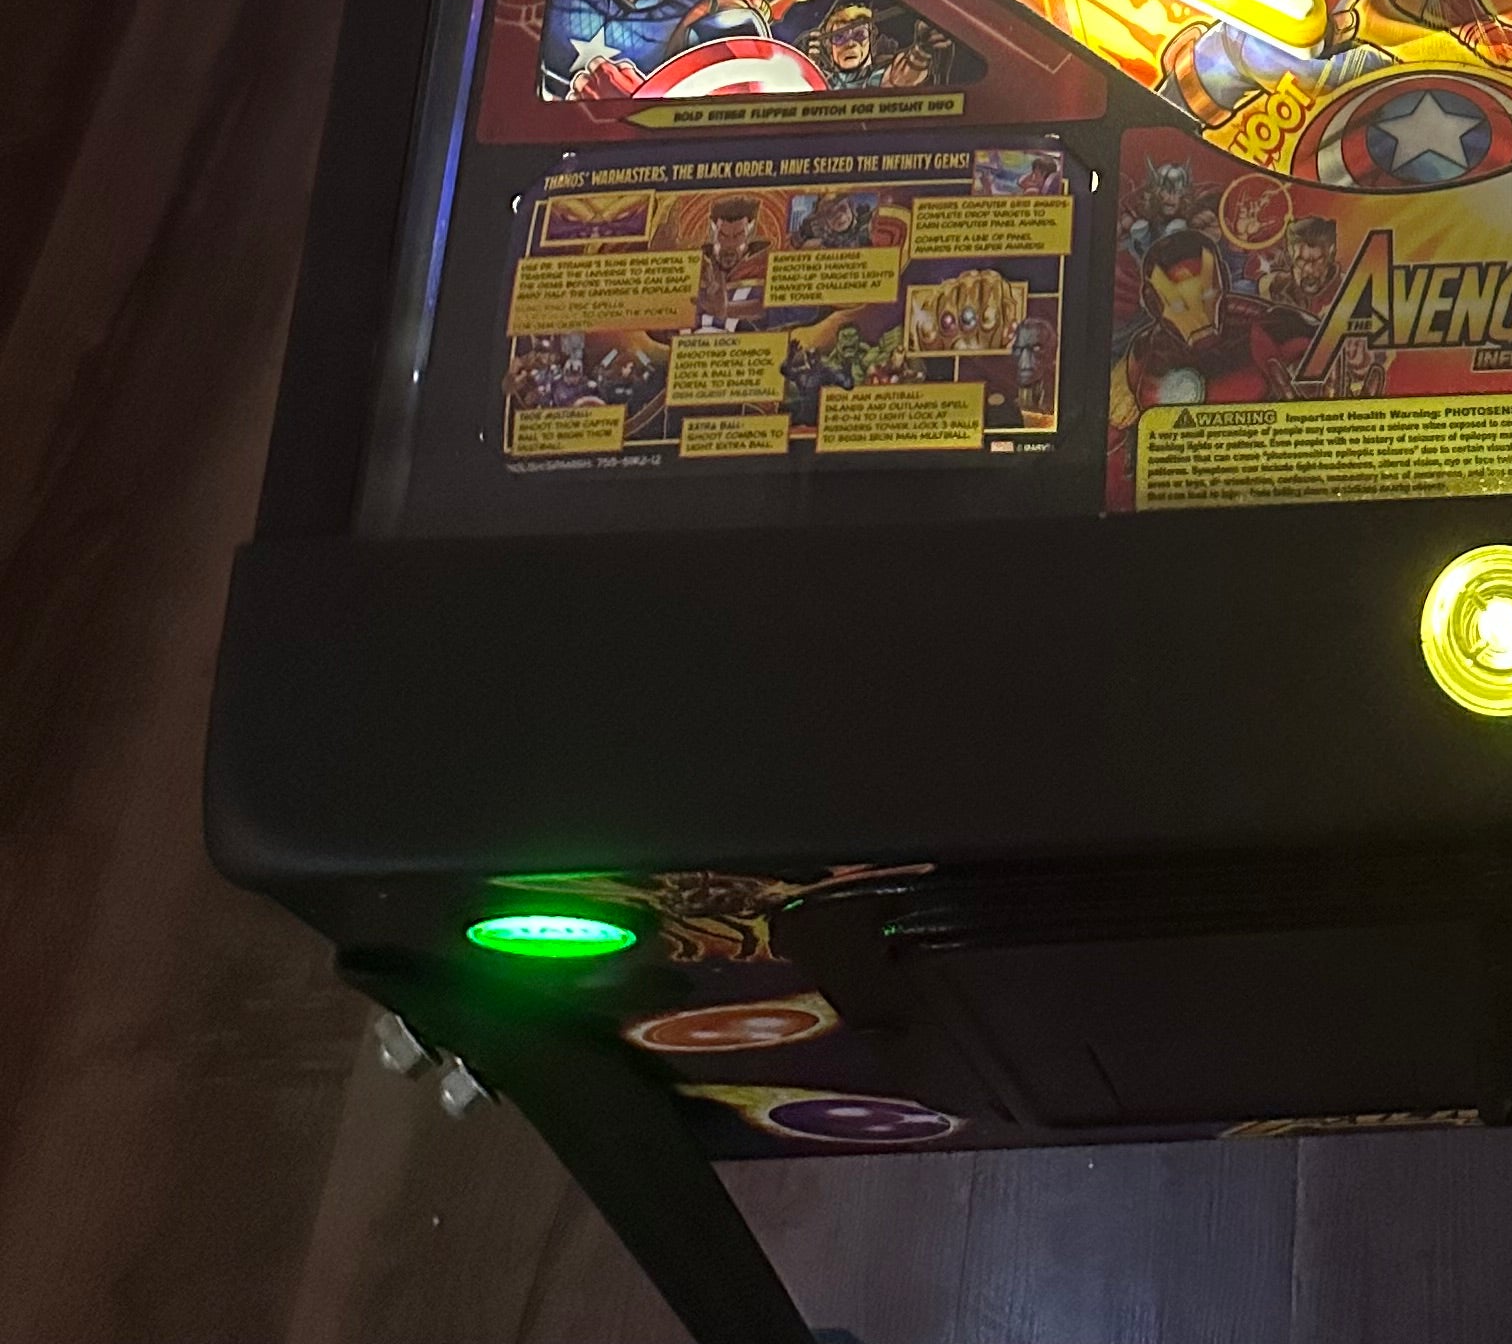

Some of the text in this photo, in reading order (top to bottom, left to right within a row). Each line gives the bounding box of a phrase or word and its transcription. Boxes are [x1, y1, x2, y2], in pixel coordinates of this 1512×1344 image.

[674, 100, 954, 123] HOLD EITHER FLIPPER BUTTON FOR INSTANT INFO
[544, 152, 970, 191] THANOS' WARMASTERS, THE BLACK ORDER, HAVE SEIZED THE INFINITY GEMS!
[1347, 319, 1373, 332] THE
[1197, 411, 1277, 426] WARNING
[1285, 413, 1344, 424] Important
[1347, 410, 1386, 420] Health
[1389, 409, 1441, 420] Warning:
